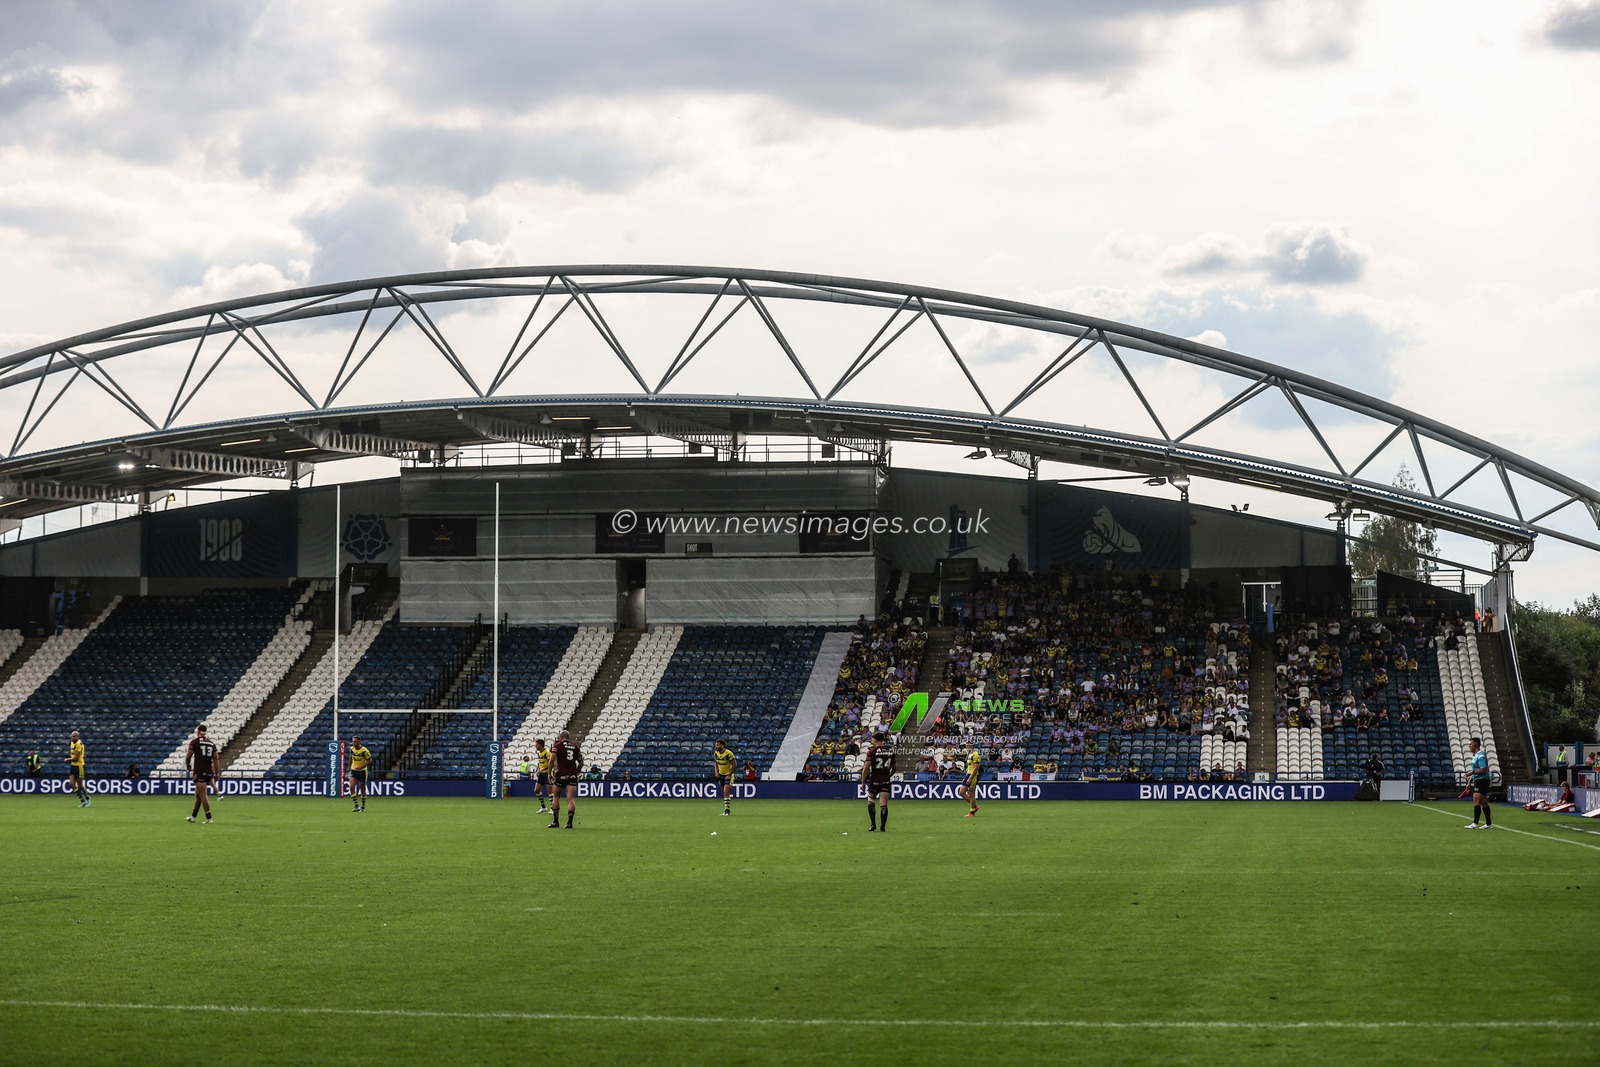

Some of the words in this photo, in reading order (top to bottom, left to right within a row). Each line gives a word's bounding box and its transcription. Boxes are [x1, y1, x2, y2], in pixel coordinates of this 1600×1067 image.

[200, 518, 243, 562] 1908
[200, 745, 214, 757] 13
[566, 749, 574, 761] 3
[875, 757, 892, 769] 24
[0, 778, 36, 793] OUD
[40, 779, 132, 794] SPOSORS
[137, 779, 160, 794] OF
[164, 780, 196, 795] THE
[343, 781, 405, 796] GANTS
[577, 782, 604, 797] BM
[610, 782, 717, 798] PACKAGING
[729, 783, 757, 798] TD
[891, 784, 1000, 799] PACKAGNG
[1007, 784, 1041, 799] LTD
[1140, 784, 1168, 800] BM
[1174, 784, 1285, 800] PACKAGING
[1291, 785, 1326, 800] LTD
